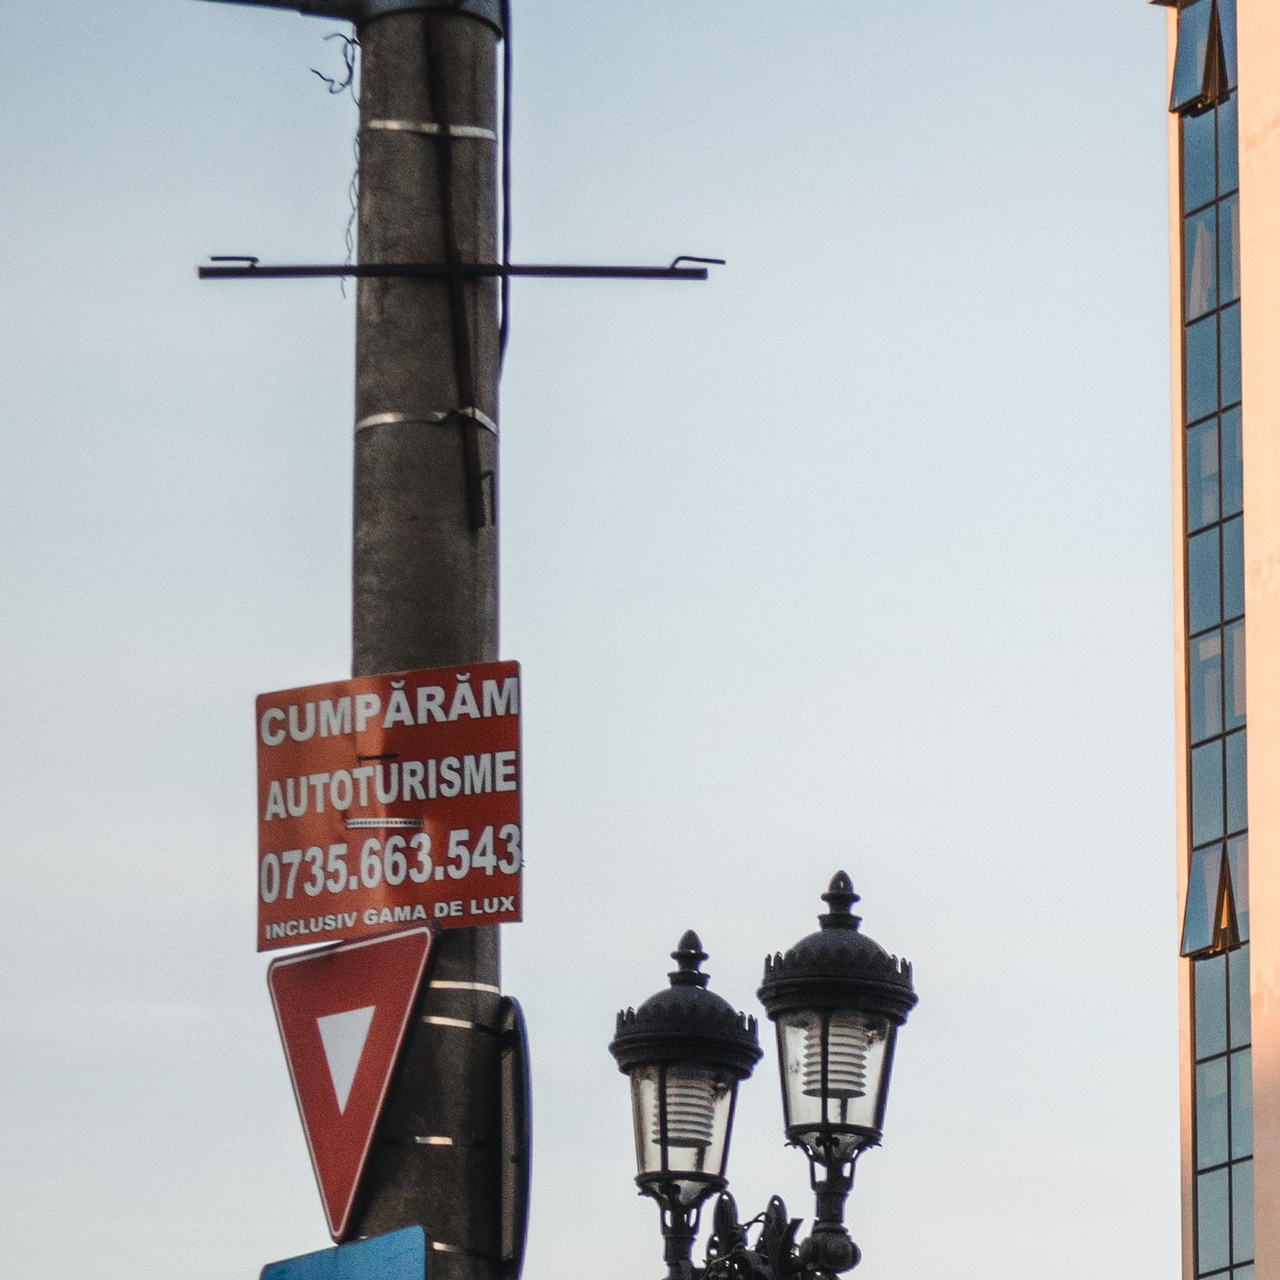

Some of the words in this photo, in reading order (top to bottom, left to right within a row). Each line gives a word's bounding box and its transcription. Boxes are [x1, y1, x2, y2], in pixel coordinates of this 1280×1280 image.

[260, 672, 519, 747] CUMPĂRĂM
[264, 750, 517, 821] AUTOTURISME
[259, 822, 521, 904] 0735.663.543
[265, 911, 357, 940] INCLUSIV
[363, 904, 427, 926] GAMA
[434, 901, 463, 918] DE
[470, 895, 515, 915] LUX
